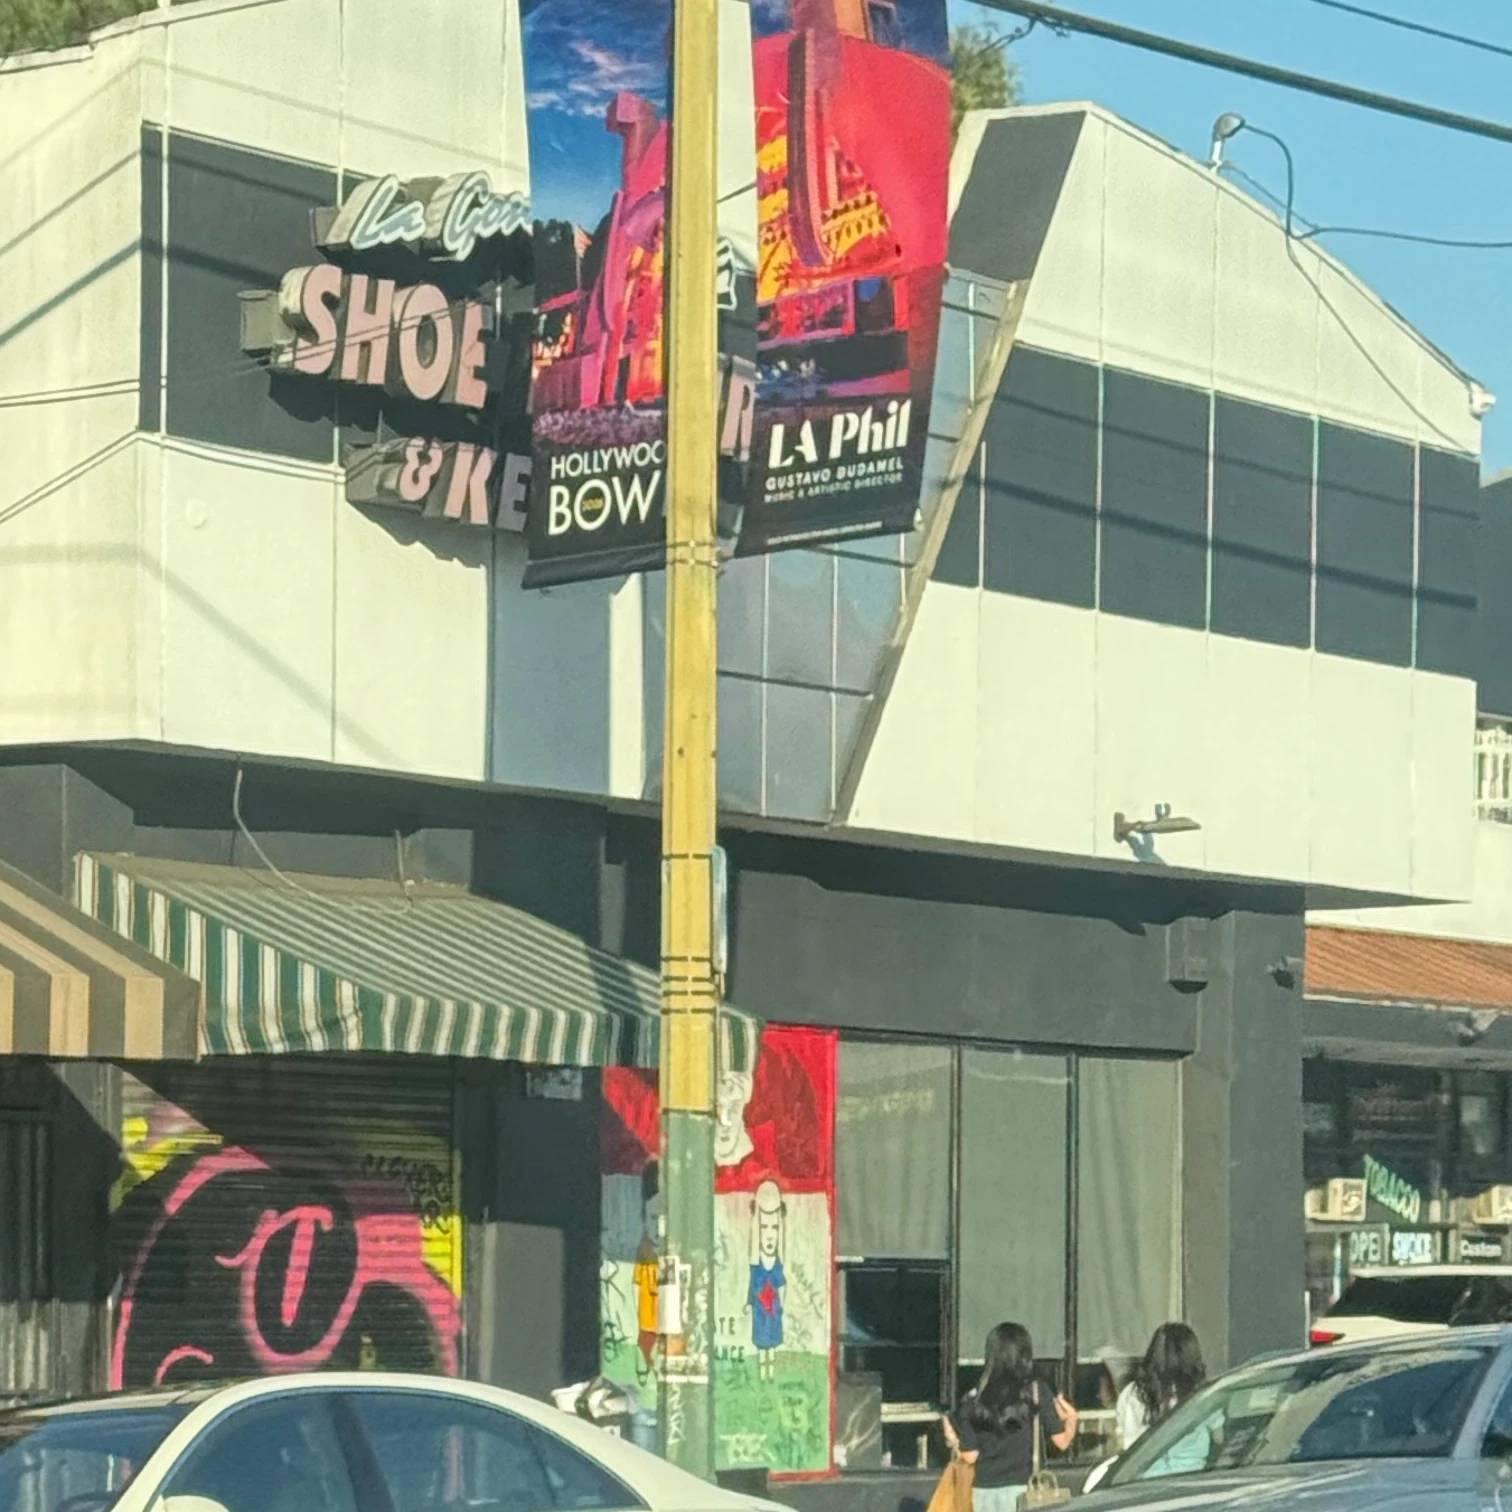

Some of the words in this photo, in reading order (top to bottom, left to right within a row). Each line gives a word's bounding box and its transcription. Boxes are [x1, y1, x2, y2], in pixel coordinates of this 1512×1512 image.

[349, 174, 426, 250] La
[292, 264, 488, 408] SHOE
[551, 440, 665, 480] HOLLYWOO
[768, 419, 818, 469] LA
[829, 398, 912, 459] Phil
[399, 437, 443, 501] &
[443, 441, 533, 532] KE
[548, 470, 661, 535] BOW
[765, 468, 831, 491] GUSTAVO
[836, 456, 904, 480] DUDAMEL
[1364, 1154, 1420, 1224] TOBACCO
